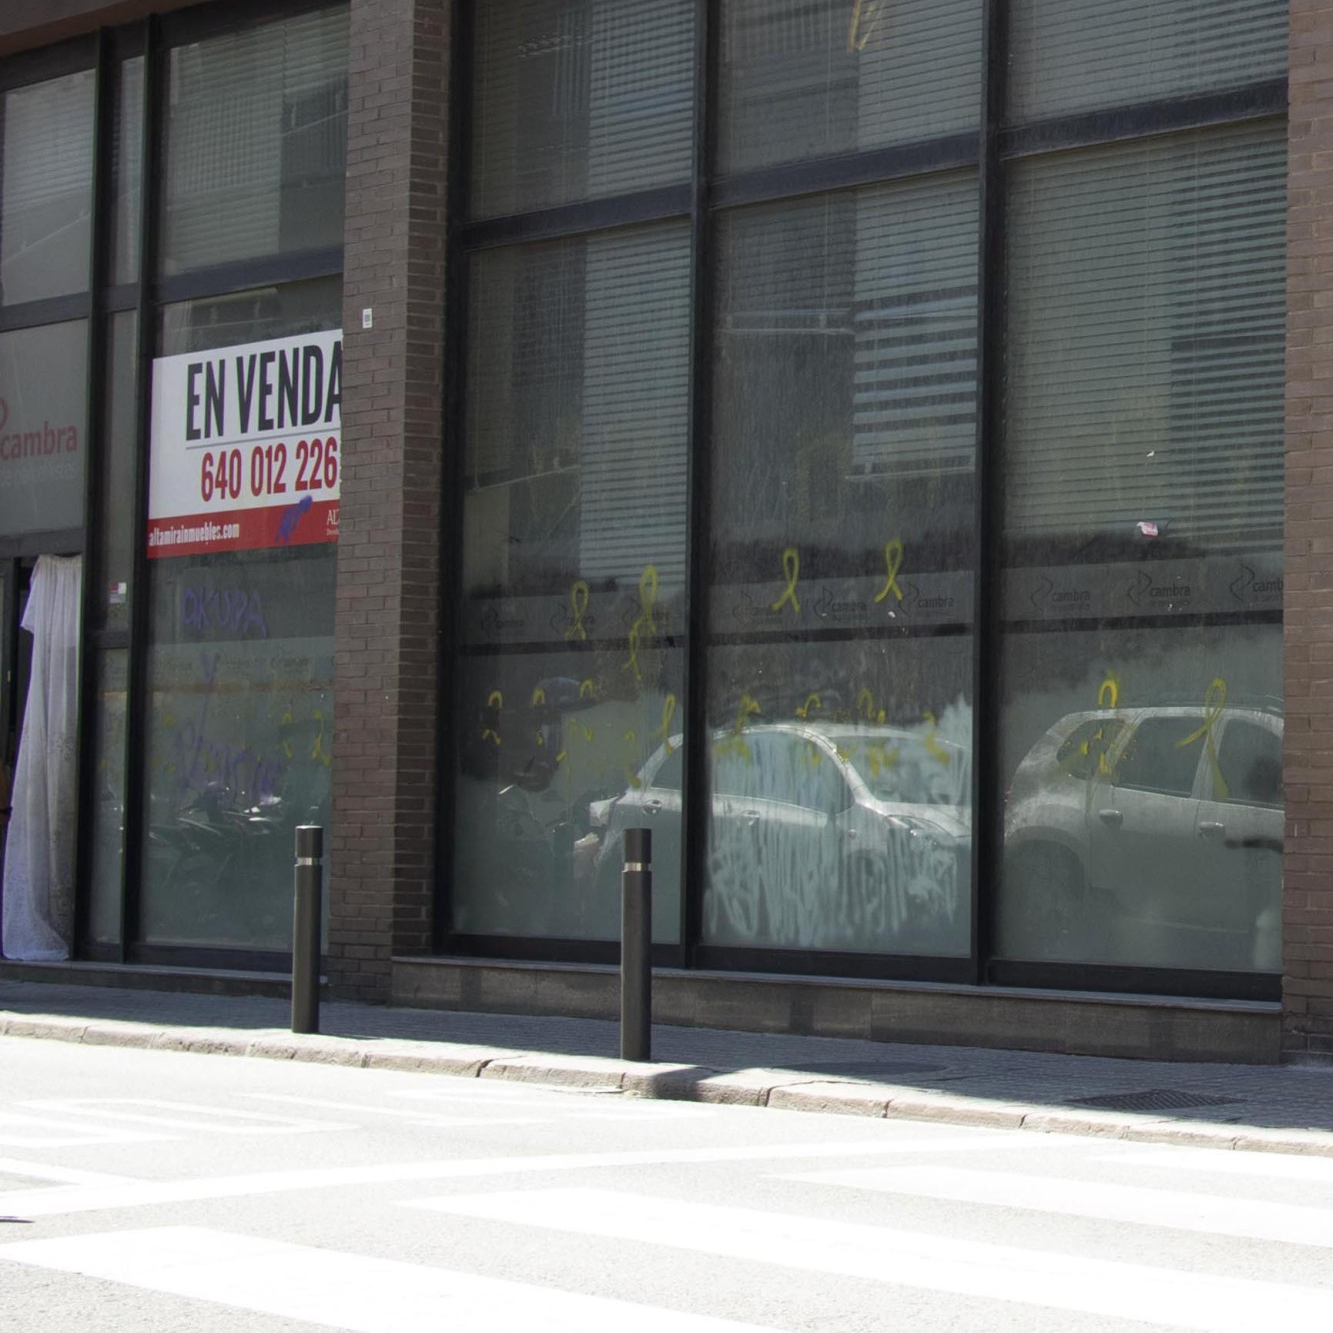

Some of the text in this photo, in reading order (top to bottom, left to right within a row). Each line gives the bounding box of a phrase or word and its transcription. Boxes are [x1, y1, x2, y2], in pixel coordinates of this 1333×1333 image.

[186, 340, 343, 441] EN VENDA
[0, 420, 78, 461] cambra
[201, 436, 338, 502] 640 012 226
[148, 521, 240, 547] altamirainmuebles.com
